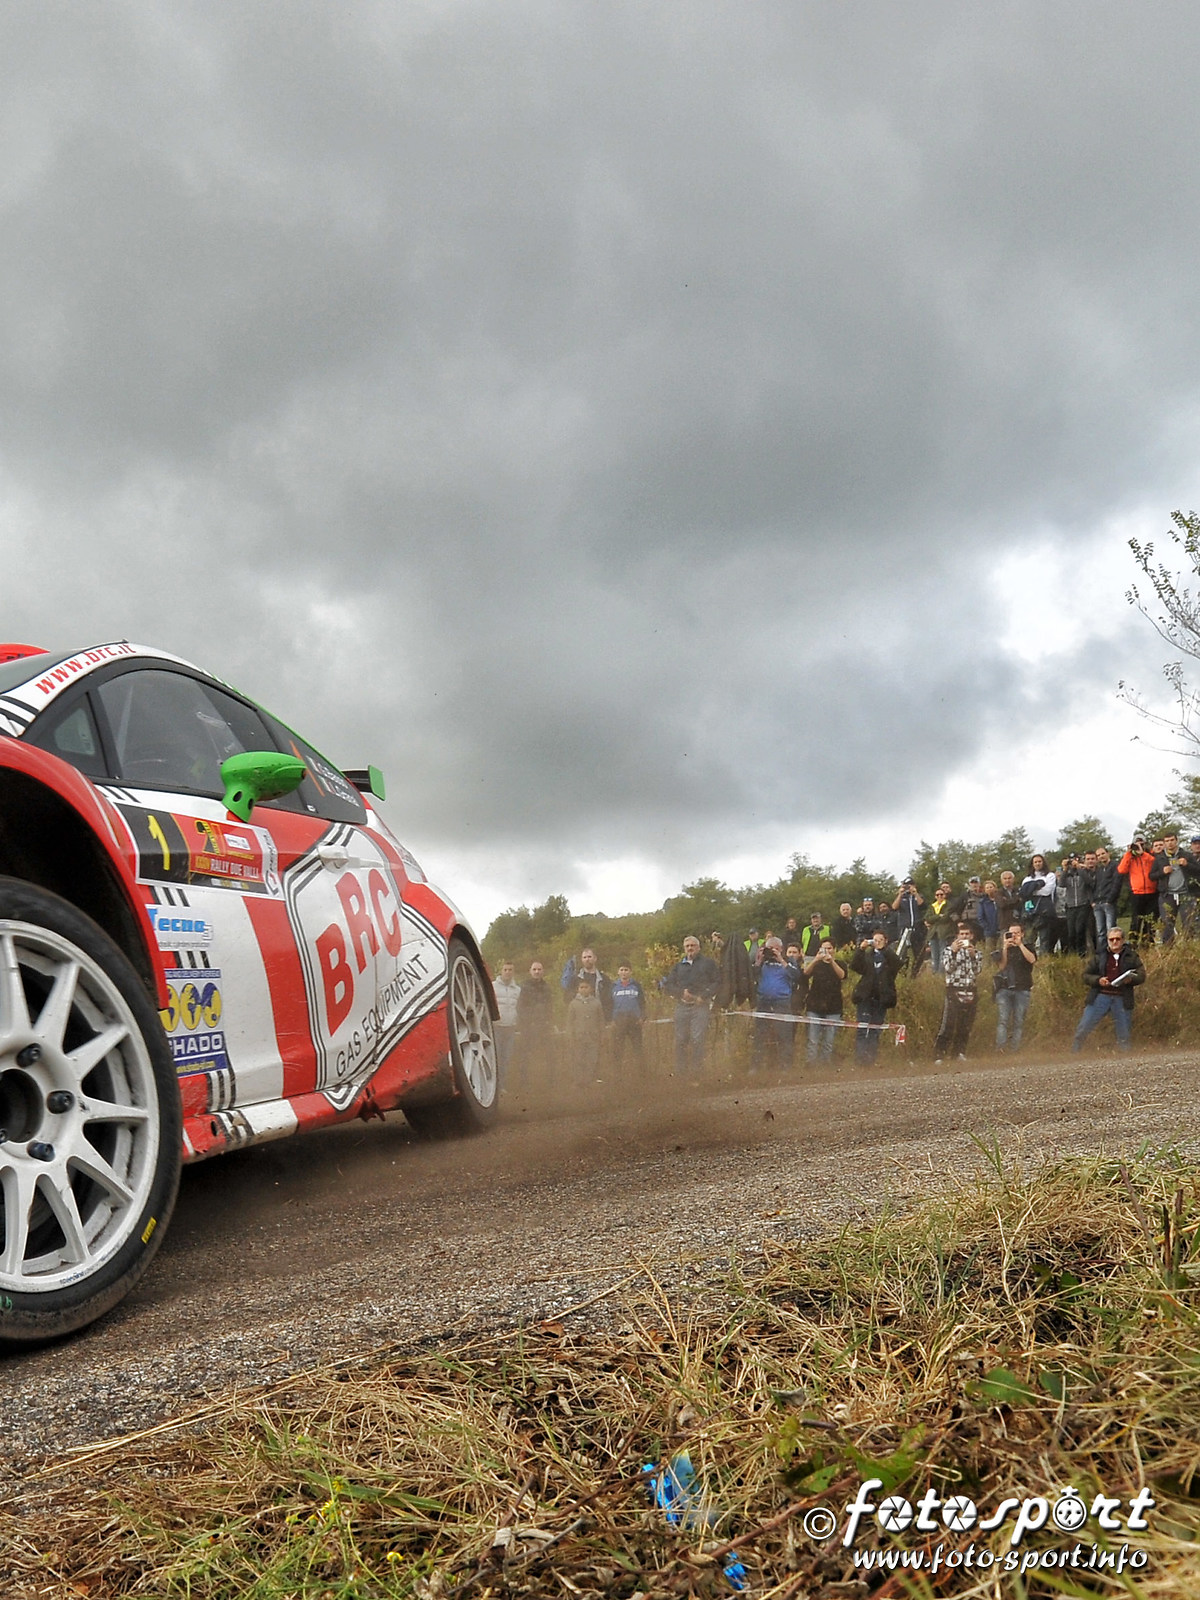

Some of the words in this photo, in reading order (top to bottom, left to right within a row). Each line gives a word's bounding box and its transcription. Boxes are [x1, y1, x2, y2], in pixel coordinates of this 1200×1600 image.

[35, 643, 137, 695] www.brc.it
[147, 814, 171, 871] 1
[315, 869, 402, 1037] BRC
[336, 1031, 362, 1078] GAS
[362, 954, 429, 1043] EQUIPMENT
